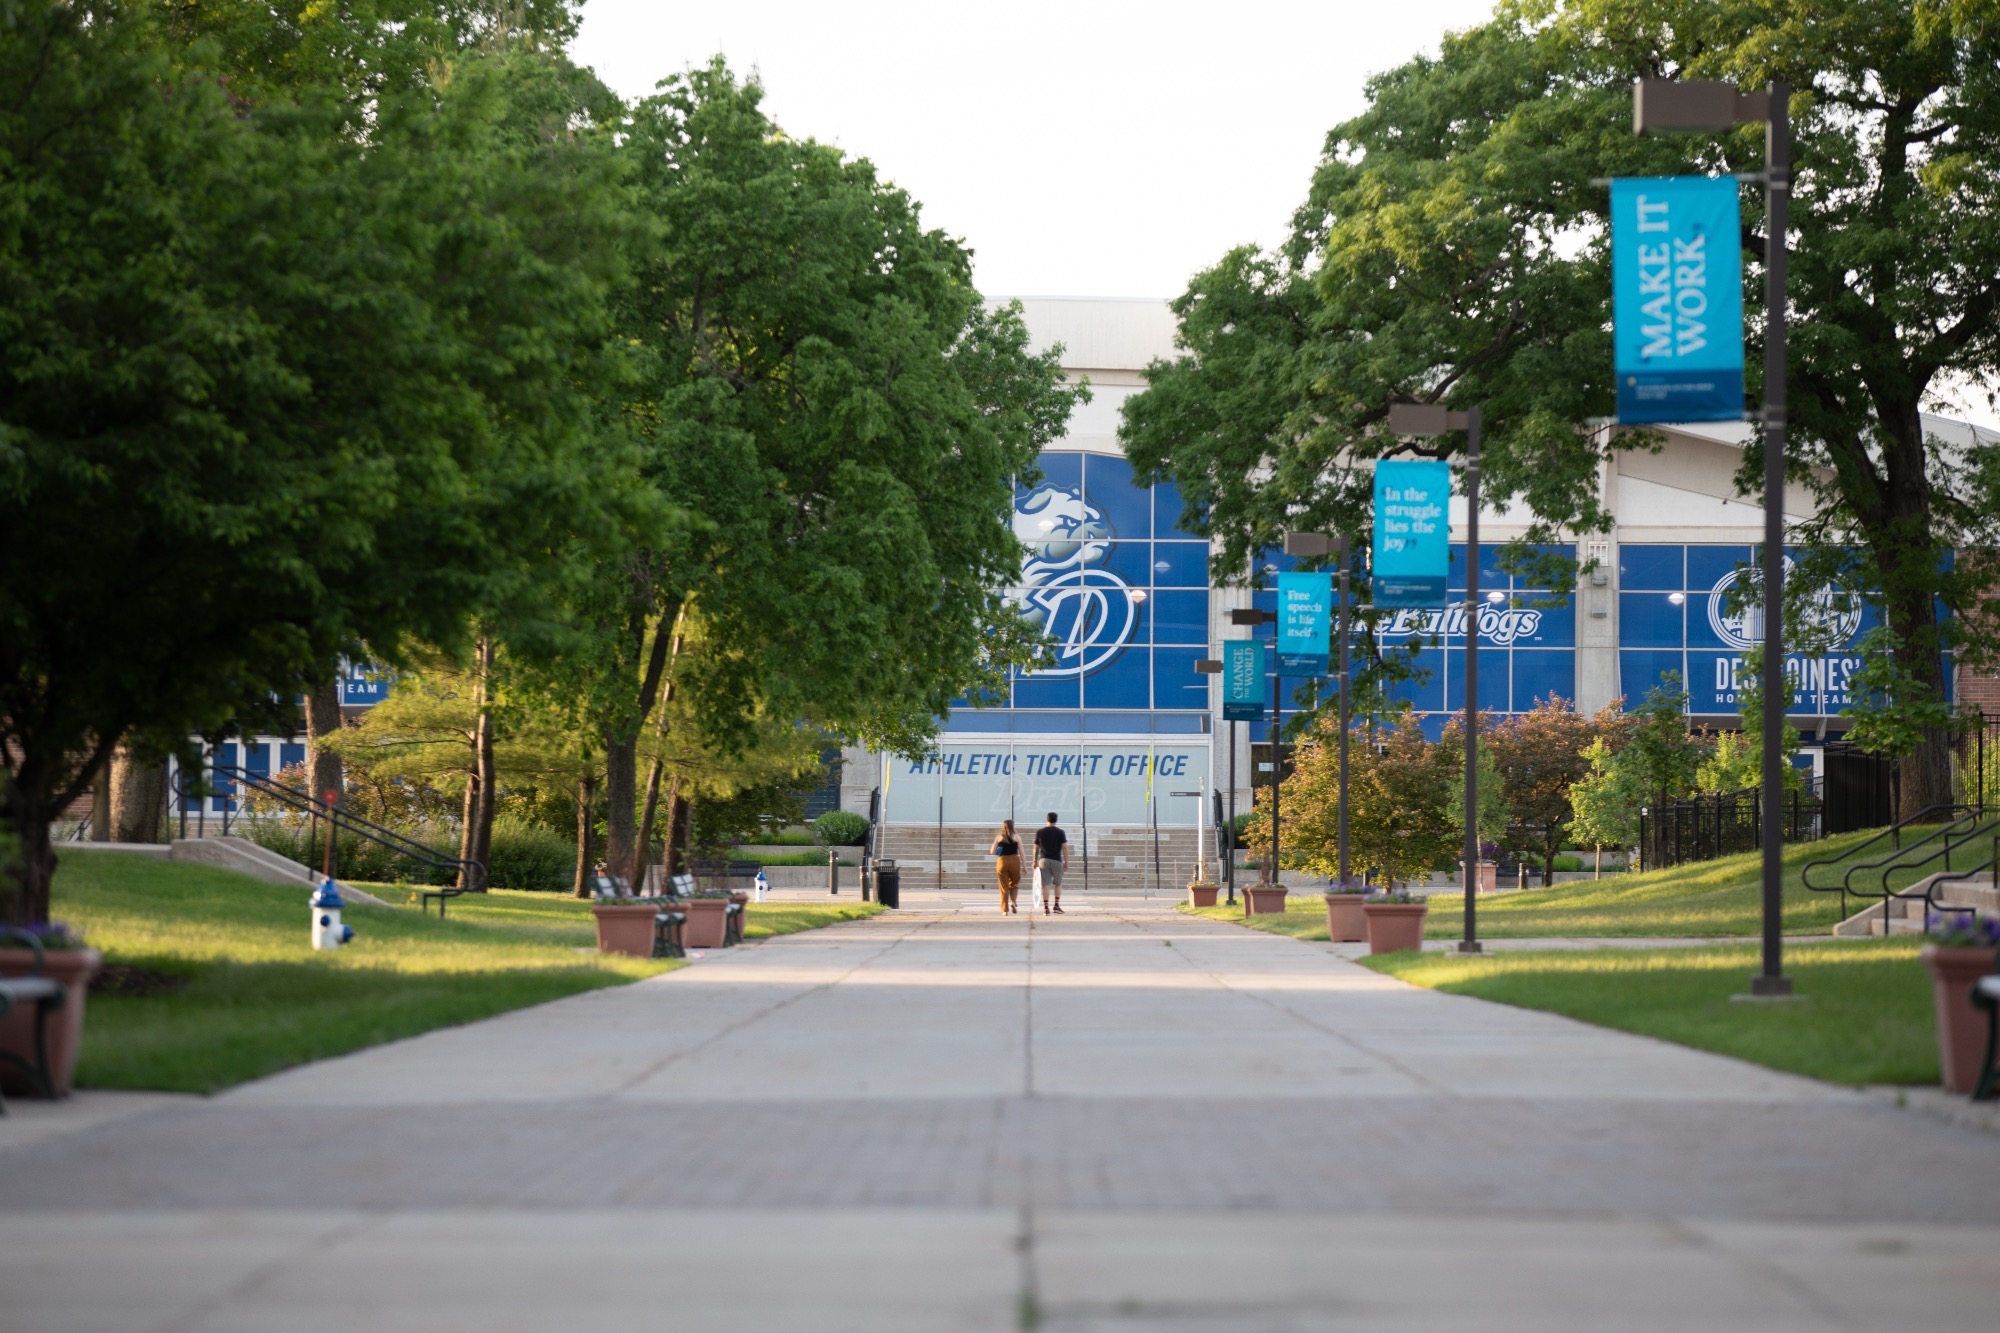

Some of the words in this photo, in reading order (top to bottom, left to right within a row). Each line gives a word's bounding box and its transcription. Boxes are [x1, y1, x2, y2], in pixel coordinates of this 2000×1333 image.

[1636, 194, 1669, 232] IT
[1404, 486, 1428, 501] the
[1384, 502, 1442, 520] struggle
[1384, 518, 1409, 533] lies
[1412, 518, 1436, 534] the
[1288, 602, 1322, 614] speech
[1288, 614, 1297, 624] is
[1299, 614, 1315, 625] life
[1233, 648, 1244, 699] CHANGE
[1245, 647, 1254, 687] WORLD
[1781, 658, 1860, 691] OINES'
[336, 684, 377, 693] TEAM
[1810, 694, 1852, 704] TEAM
[908, 753, 1017, 775] ATHLETIC
[1026, 754, 1103, 776] TICKET
[1109, 754, 1189, 776] OFFICE
